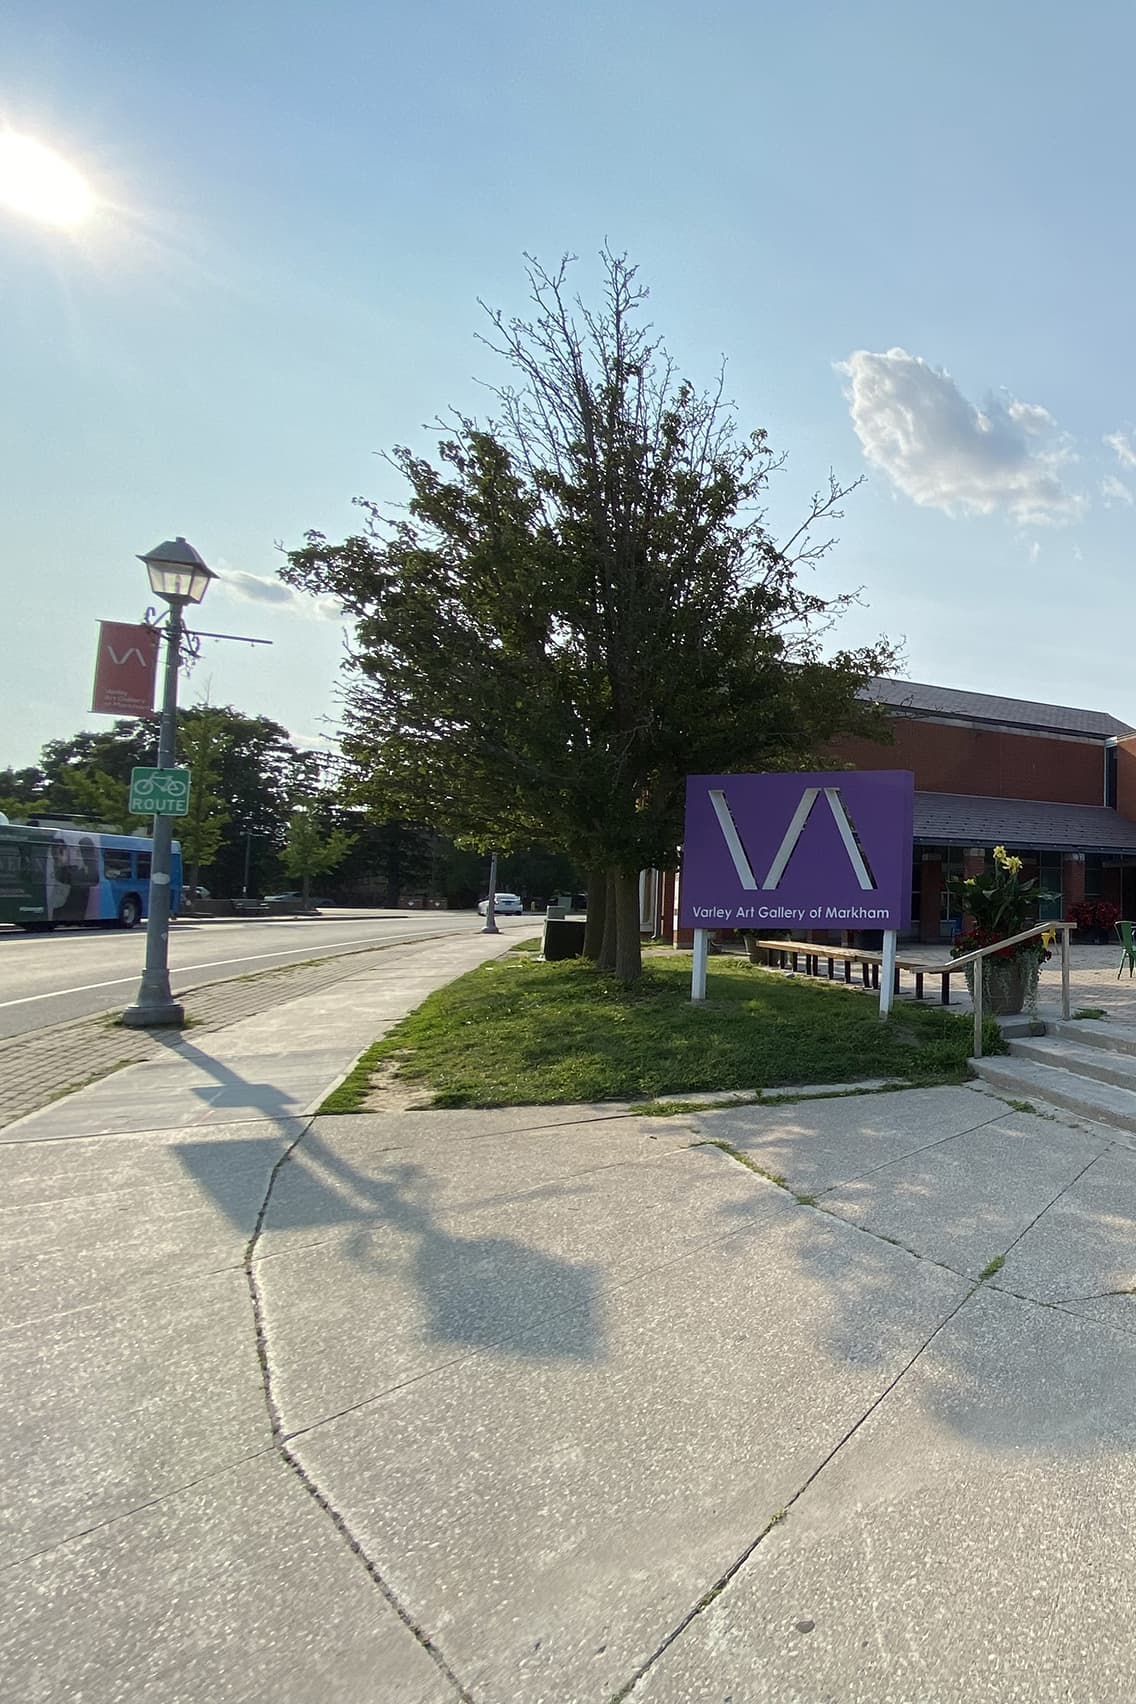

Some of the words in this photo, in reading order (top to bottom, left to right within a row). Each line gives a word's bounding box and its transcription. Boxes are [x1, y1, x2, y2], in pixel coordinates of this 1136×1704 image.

[132, 798, 186, 812] ROUTE
[692, 906, 732, 921] Varley
[735, 906, 755, 918] Art
[758, 906, 806, 921] Gallery
[809, 906, 822, 919] of
[825, 906, 890, 919] Markham
